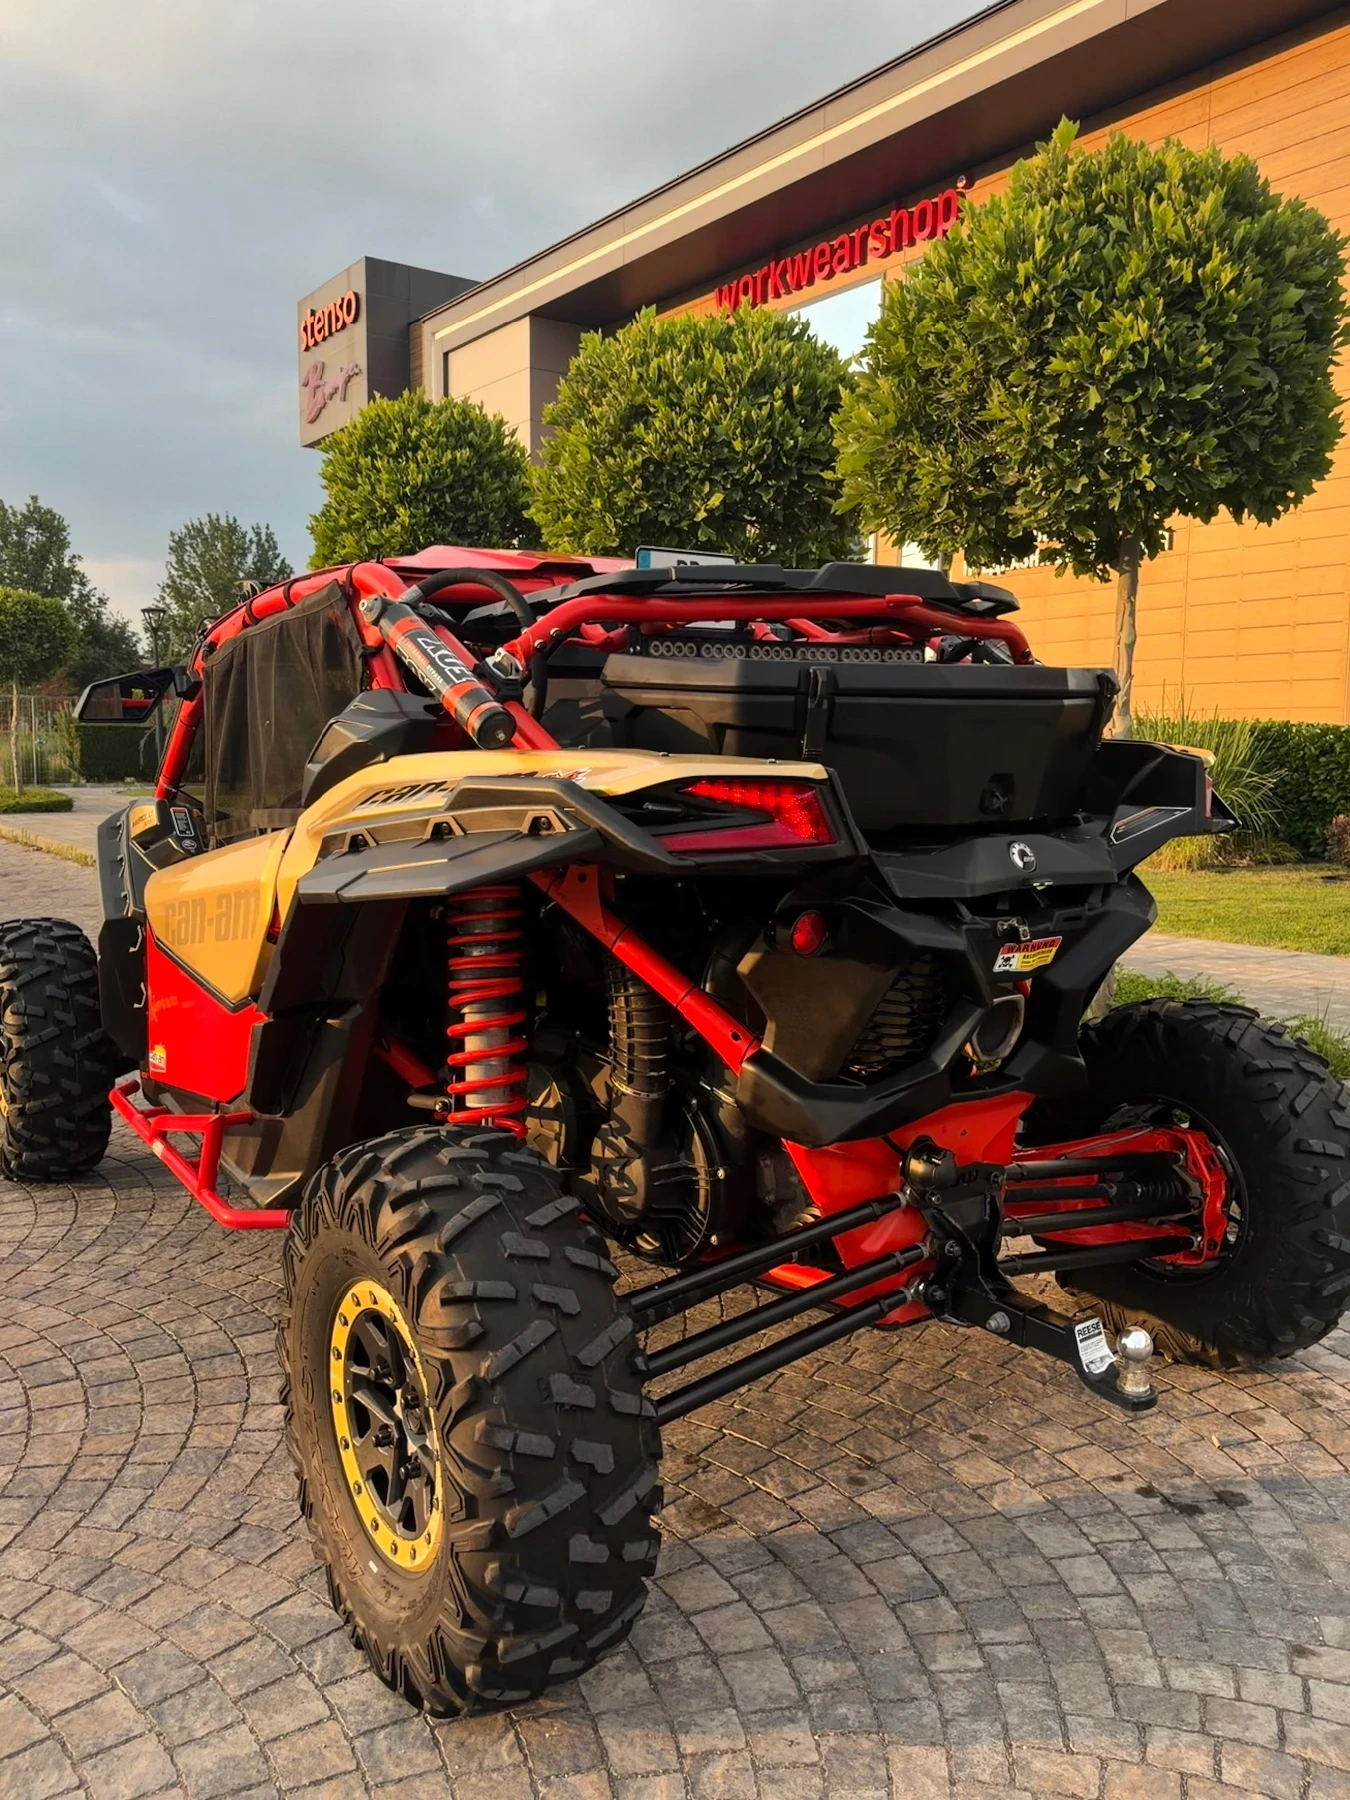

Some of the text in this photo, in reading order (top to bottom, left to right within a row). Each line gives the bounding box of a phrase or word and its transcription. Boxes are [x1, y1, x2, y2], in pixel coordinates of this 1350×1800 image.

[714, 188, 960, 313] workwearshop
[300, 290, 357, 351] stenso
[164, 888, 260, 946] can-am
[1076, 1322, 1101, 1338] REESE
